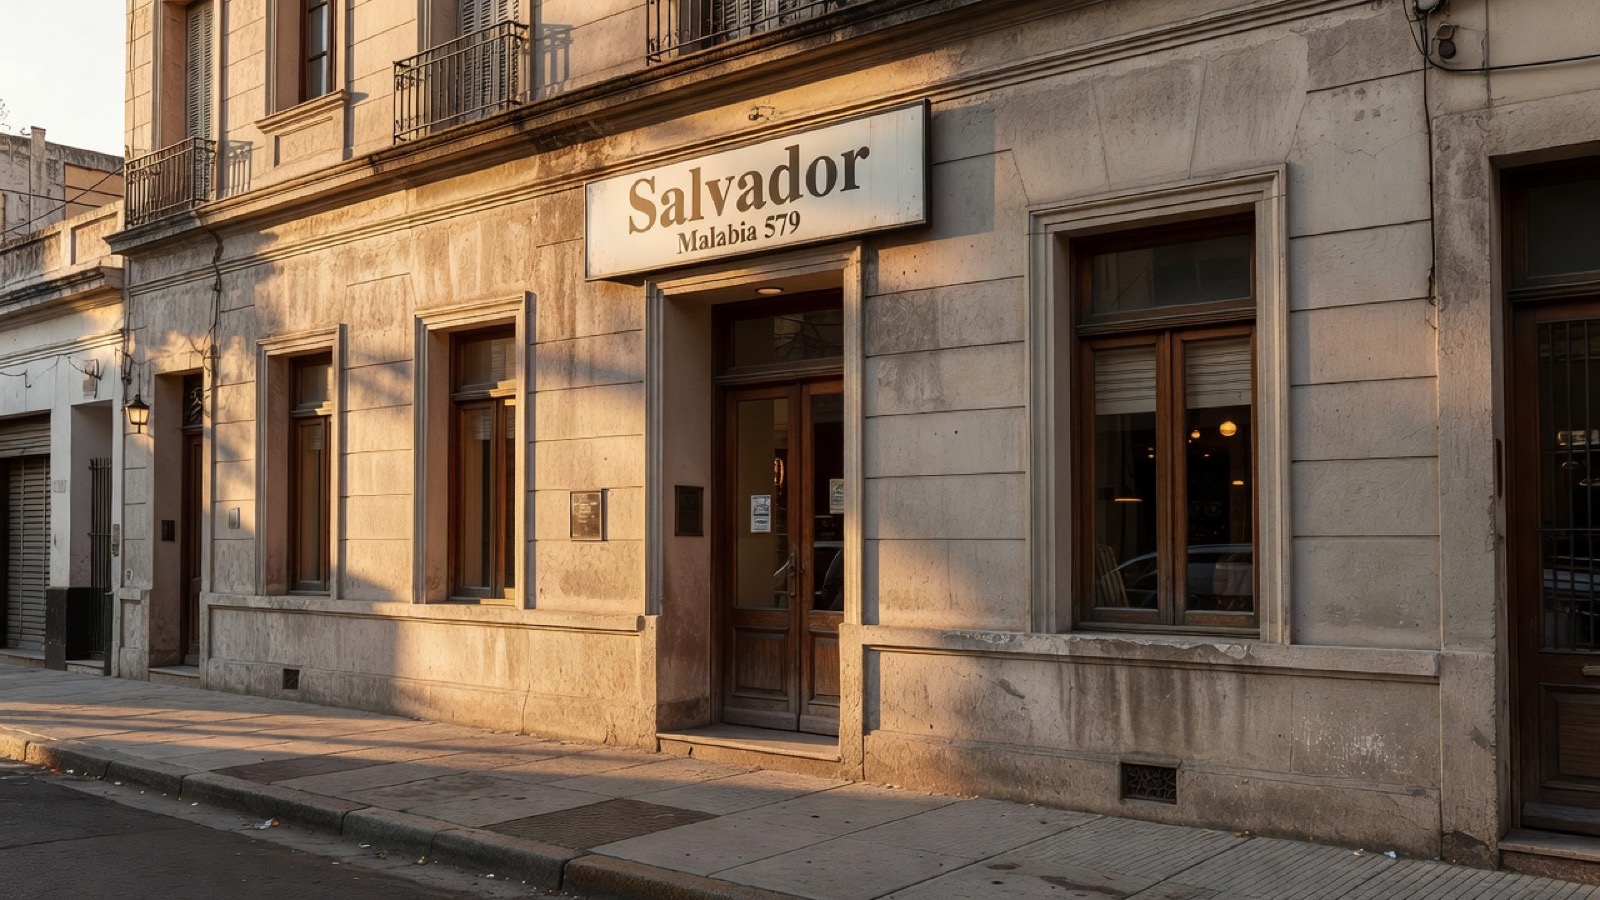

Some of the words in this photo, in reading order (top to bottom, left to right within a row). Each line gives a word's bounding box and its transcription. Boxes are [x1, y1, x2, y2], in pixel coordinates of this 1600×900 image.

[629, 144, 870, 235] Salvador
[676, 221, 758, 254] Malabia
[764, 210, 801, 238] 579
